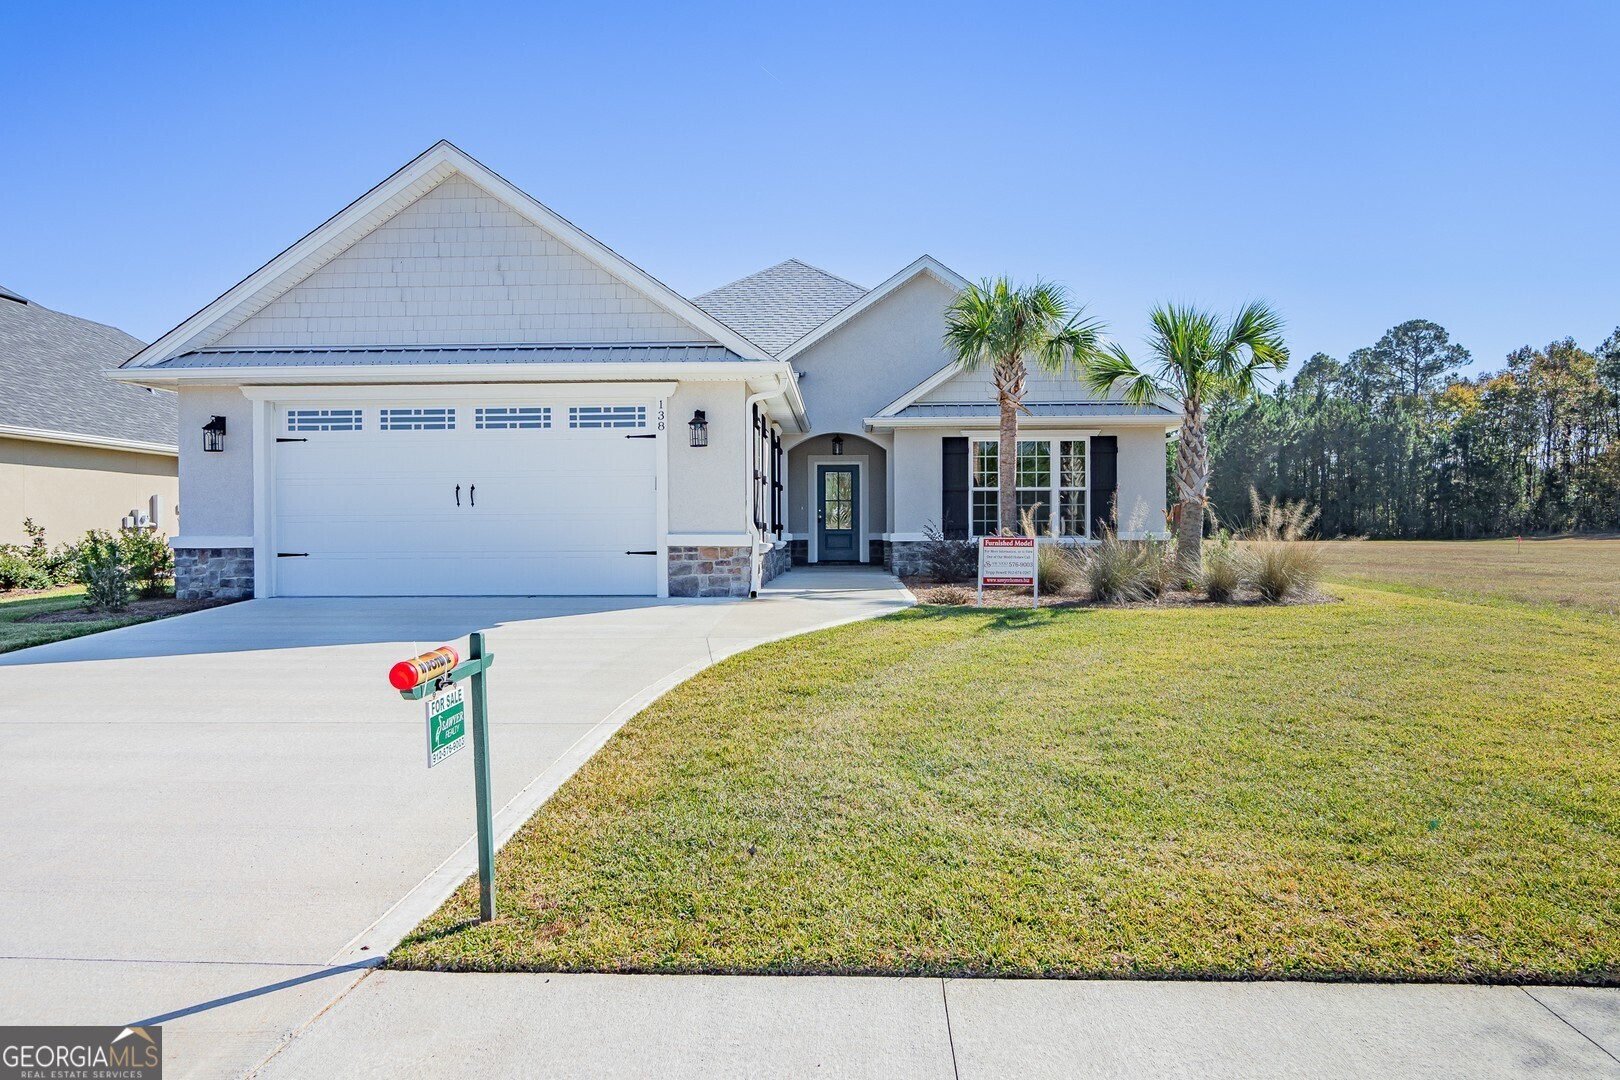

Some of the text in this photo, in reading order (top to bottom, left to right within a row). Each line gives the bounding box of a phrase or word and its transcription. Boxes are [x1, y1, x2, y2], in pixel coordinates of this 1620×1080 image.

[432, 689, 462, 715] FOR SALE
[441, 711, 464, 731] SAWYER
[445, 724, 460, 739] REALTY
[433, 737, 464, 763] 912-576-9003
